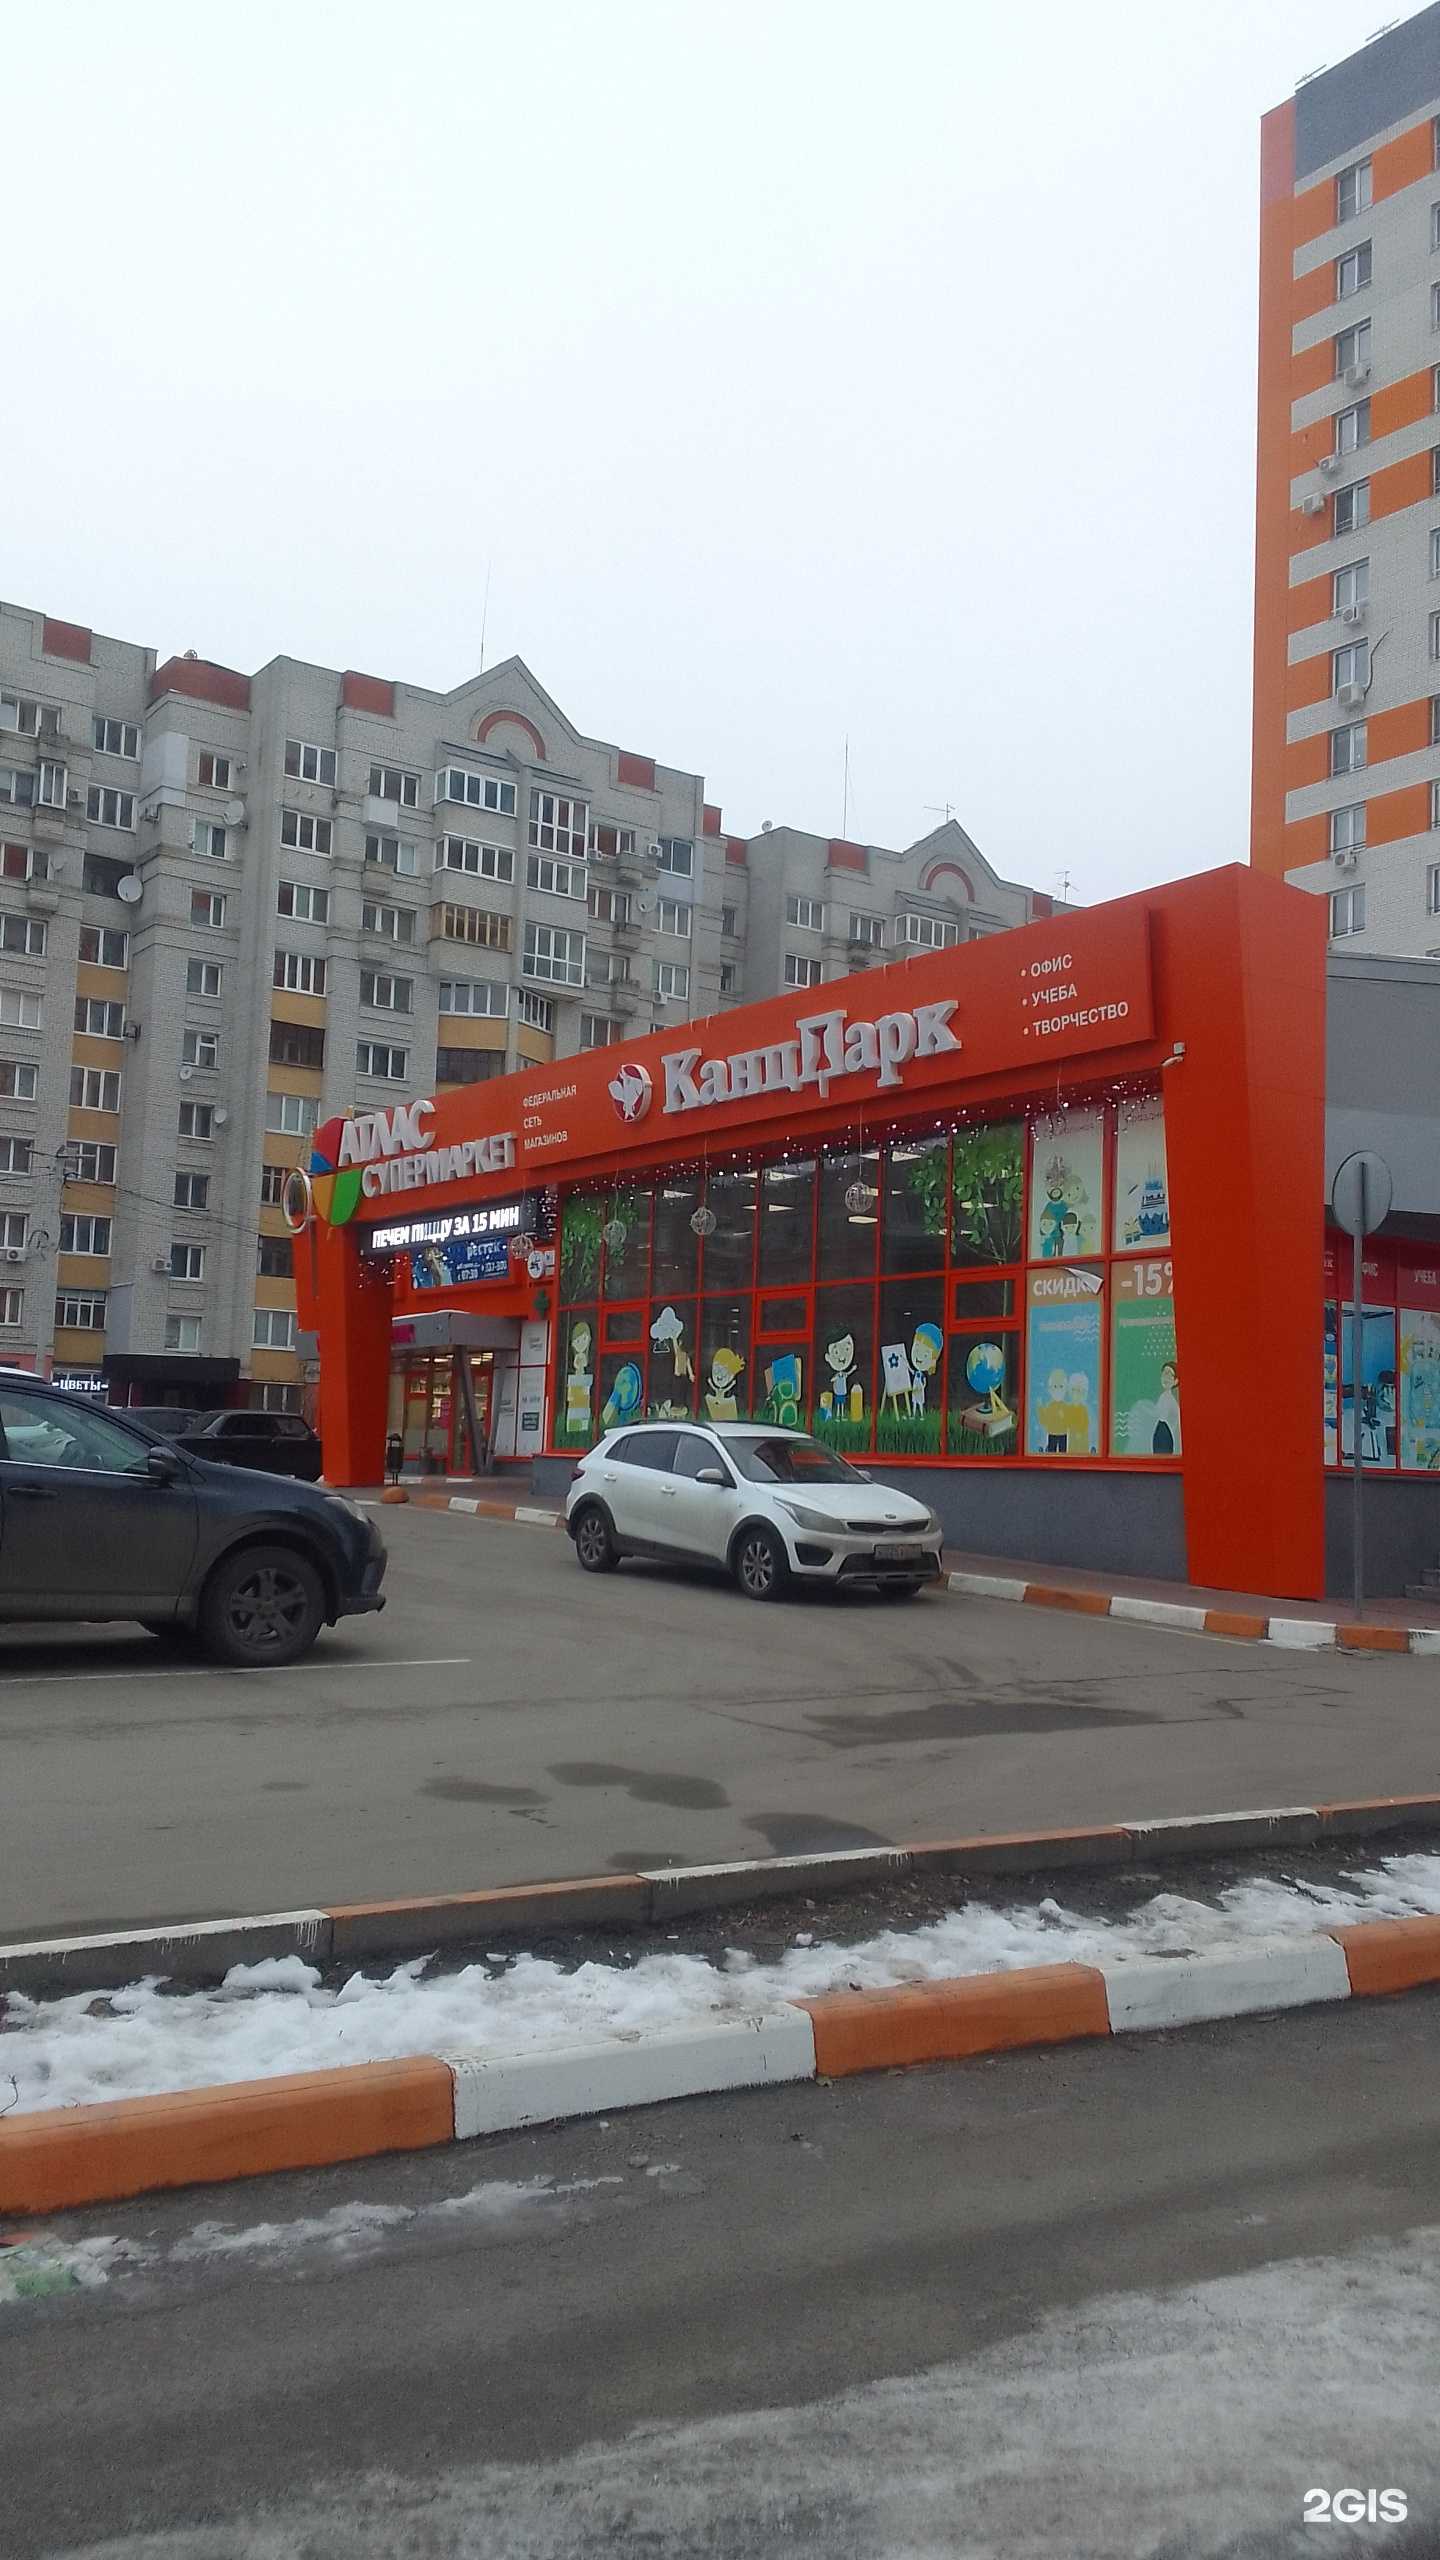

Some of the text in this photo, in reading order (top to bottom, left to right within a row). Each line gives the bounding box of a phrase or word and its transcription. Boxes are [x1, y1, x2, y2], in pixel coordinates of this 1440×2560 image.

[1030, 953, 1073, 977] ОФИС
[1031, 983, 1078, 1007] УЧЕБА
[1032, 1001, 1129, 1036] ТВОРЧЕСТВО
[661, 1000, 962, 1114] КанцПарк
[522, 1084, 577, 1107] ФЕДЕРАЛЬНАЯ
[338, 1099, 436, 1167] АТЛАС
[523, 1115, 542, 1129] СЕТЬ
[523, 1130, 568, 1150] МАГАЗИНОВ
[361, 1132, 517, 1198] СУПЕРМАРКЕТ
[372, 1206, 520, 1249] ПЕЧЕМ ПИЦЦУ ЗА 15 МИН
[1033, 1275, 1093, 1298] СКИДК
